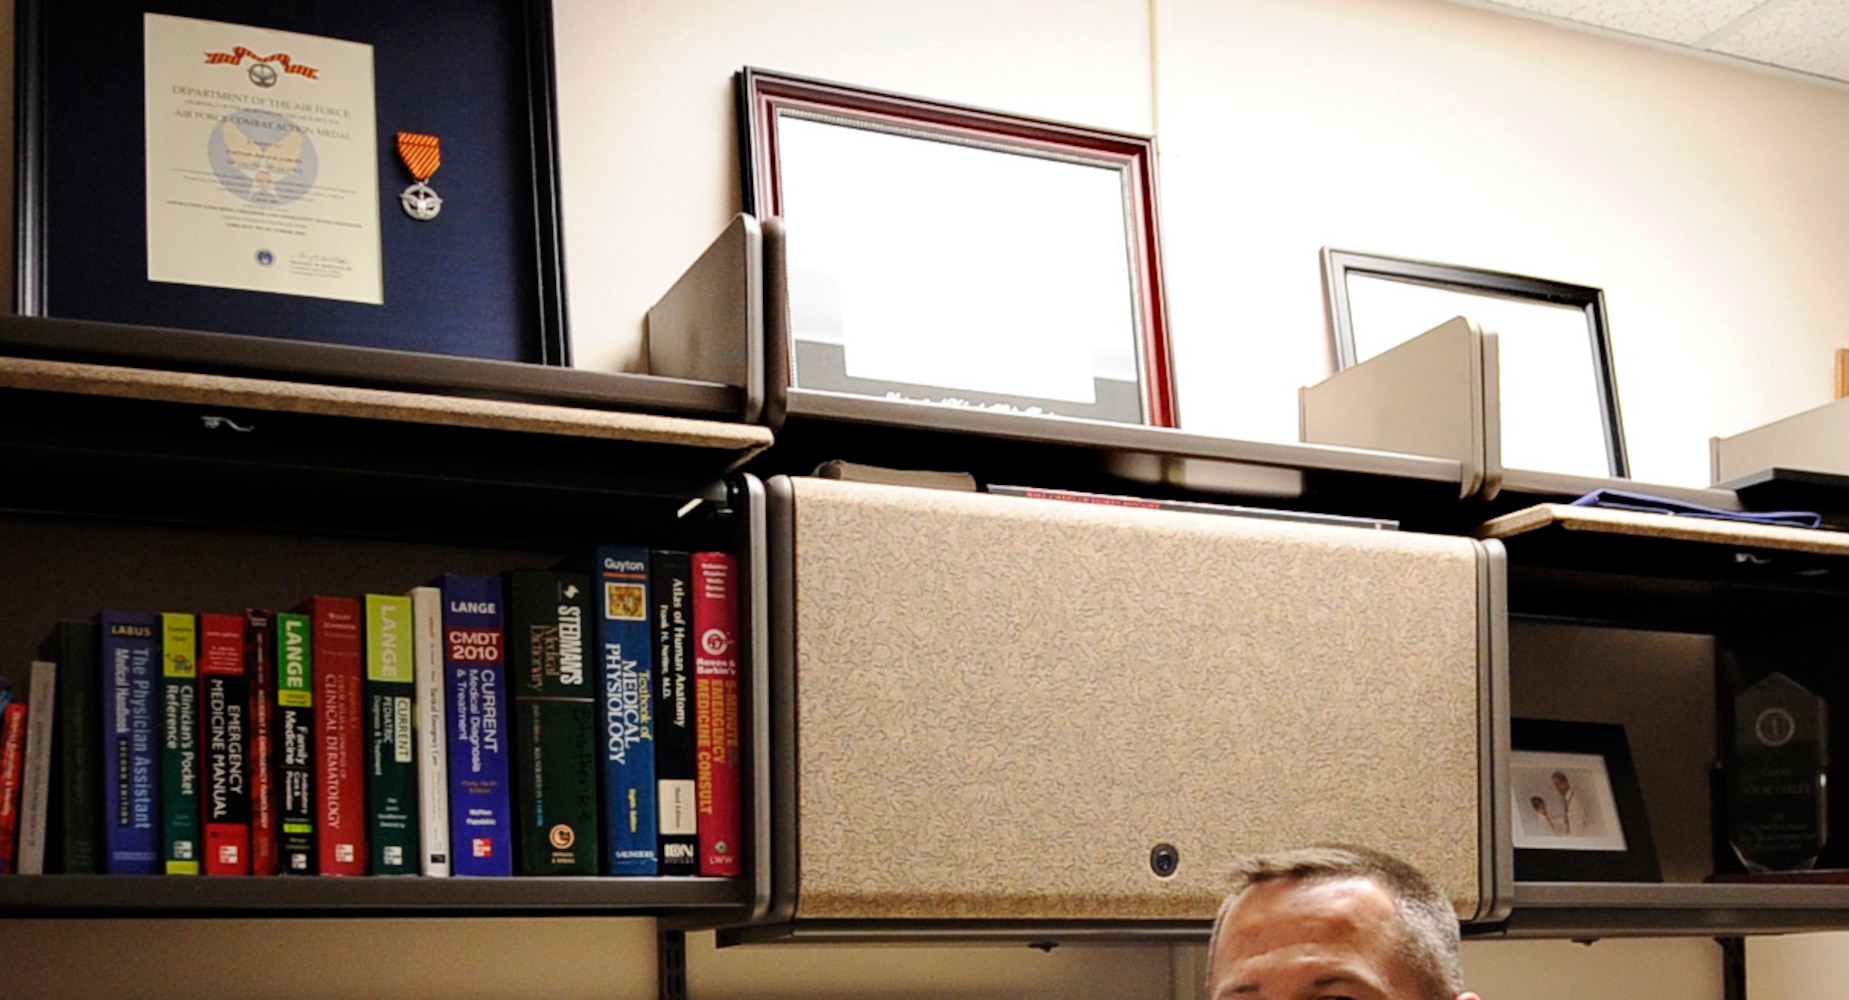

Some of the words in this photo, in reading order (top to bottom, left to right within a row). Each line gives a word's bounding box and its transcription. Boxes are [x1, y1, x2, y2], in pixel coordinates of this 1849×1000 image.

[172, 85, 249, 103] DEPARTMENT
[251, 95, 265, 104] OF
[270, 98, 291, 108] THE
[294, 101, 312, 111] AIR
[315, 105, 350, 117] FORCE
[174, 109, 193, 117] AIR
[195, 112, 227, 122] FORCE
[230, 116, 273, 128] COMBAT
[275, 122, 315, 135] ACTION
[316, 127, 351, 140] MEDAL
[604, 557, 645, 572] Guyton
[451, 601, 496, 614] LANGE
[659, 604, 670, 629] Frank
[672, 579, 685, 607] Atlas
[673, 610, 686, 624] of
[111, 624, 152, 637] LABUS
[285, 620, 303, 688] LANGE
[381, 605, 398, 677] LANGE
[450, 631, 499, 646] CMDT
[452, 646, 498, 661] 2010
[544, 626, 560, 677] Medical
[558, 605, 583, 686] STEDMAN'S
[673, 626, 686, 671] Human
[132, 648, 149, 674] The
[456, 668, 466, 678] &
[527, 625, 545, 693] Dictionary
[130, 680, 150, 751] Physician
[166, 684, 179, 750] Reference
[180, 684, 194, 749] Clinician's
[210, 679, 225, 751] MEDICINE
[325, 673, 338, 731] CLINICAL
[456, 681, 468, 740] Treatment
[468, 668, 479, 714] Medical
[480, 669, 498, 753] CURRENT
[605, 642, 625, 765] PHYSIOLOGY
[621, 659, 640, 749] MEDICAL
[638, 669, 652, 724] Textbook
[672, 673, 686, 727] Anatomy
[697, 679, 711, 747] MEDICINE
[726, 680, 738, 747] 5-MINUTE
[284, 710, 297, 765] Medicine
[294, 725, 308, 765] Family
[383, 696, 393, 745] PEDIATRIC
[397, 699, 408, 758] CURRENT
[469, 716, 482, 772] Diagnosis
[639, 725, 653, 741] of
[711, 679, 725, 764] EMERGENCY
[181, 751, 194, 795] Pocket
[227, 705, 243, 795] EMERGENCY
[133, 756, 151, 829] Assistant
[212, 754, 227, 819] MANUAL
[326, 736, 340, 829] DERMATOLOGY
[698, 751, 713, 815] CONSULT
[709, 855, 733, 864] LWW
